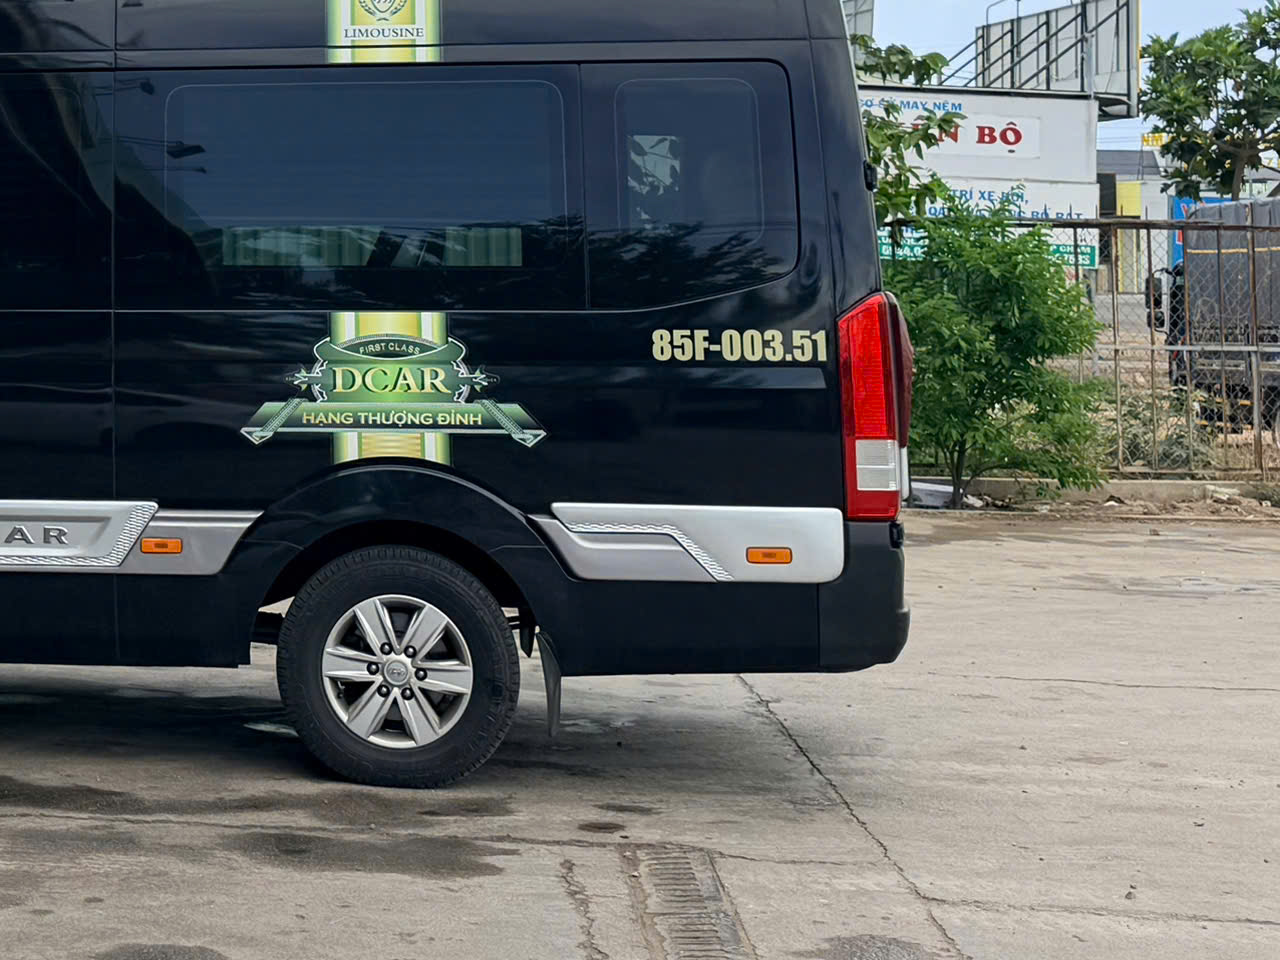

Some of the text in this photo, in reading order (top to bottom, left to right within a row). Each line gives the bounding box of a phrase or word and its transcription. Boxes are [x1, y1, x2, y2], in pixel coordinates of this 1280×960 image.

[344, 27, 424, 39] LIMOUSINE
[975, 121, 1023, 153] BỘ
[978, 190, 996, 201] XE
[359, 343, 420, 355] FIRST CLASS
[652, 329, 827, 362] 85F-003.51
[331, 366, 452, 394] DCAR
[302, 409, 483, 428] HẠNG THƯỢNG ĐỈNH
